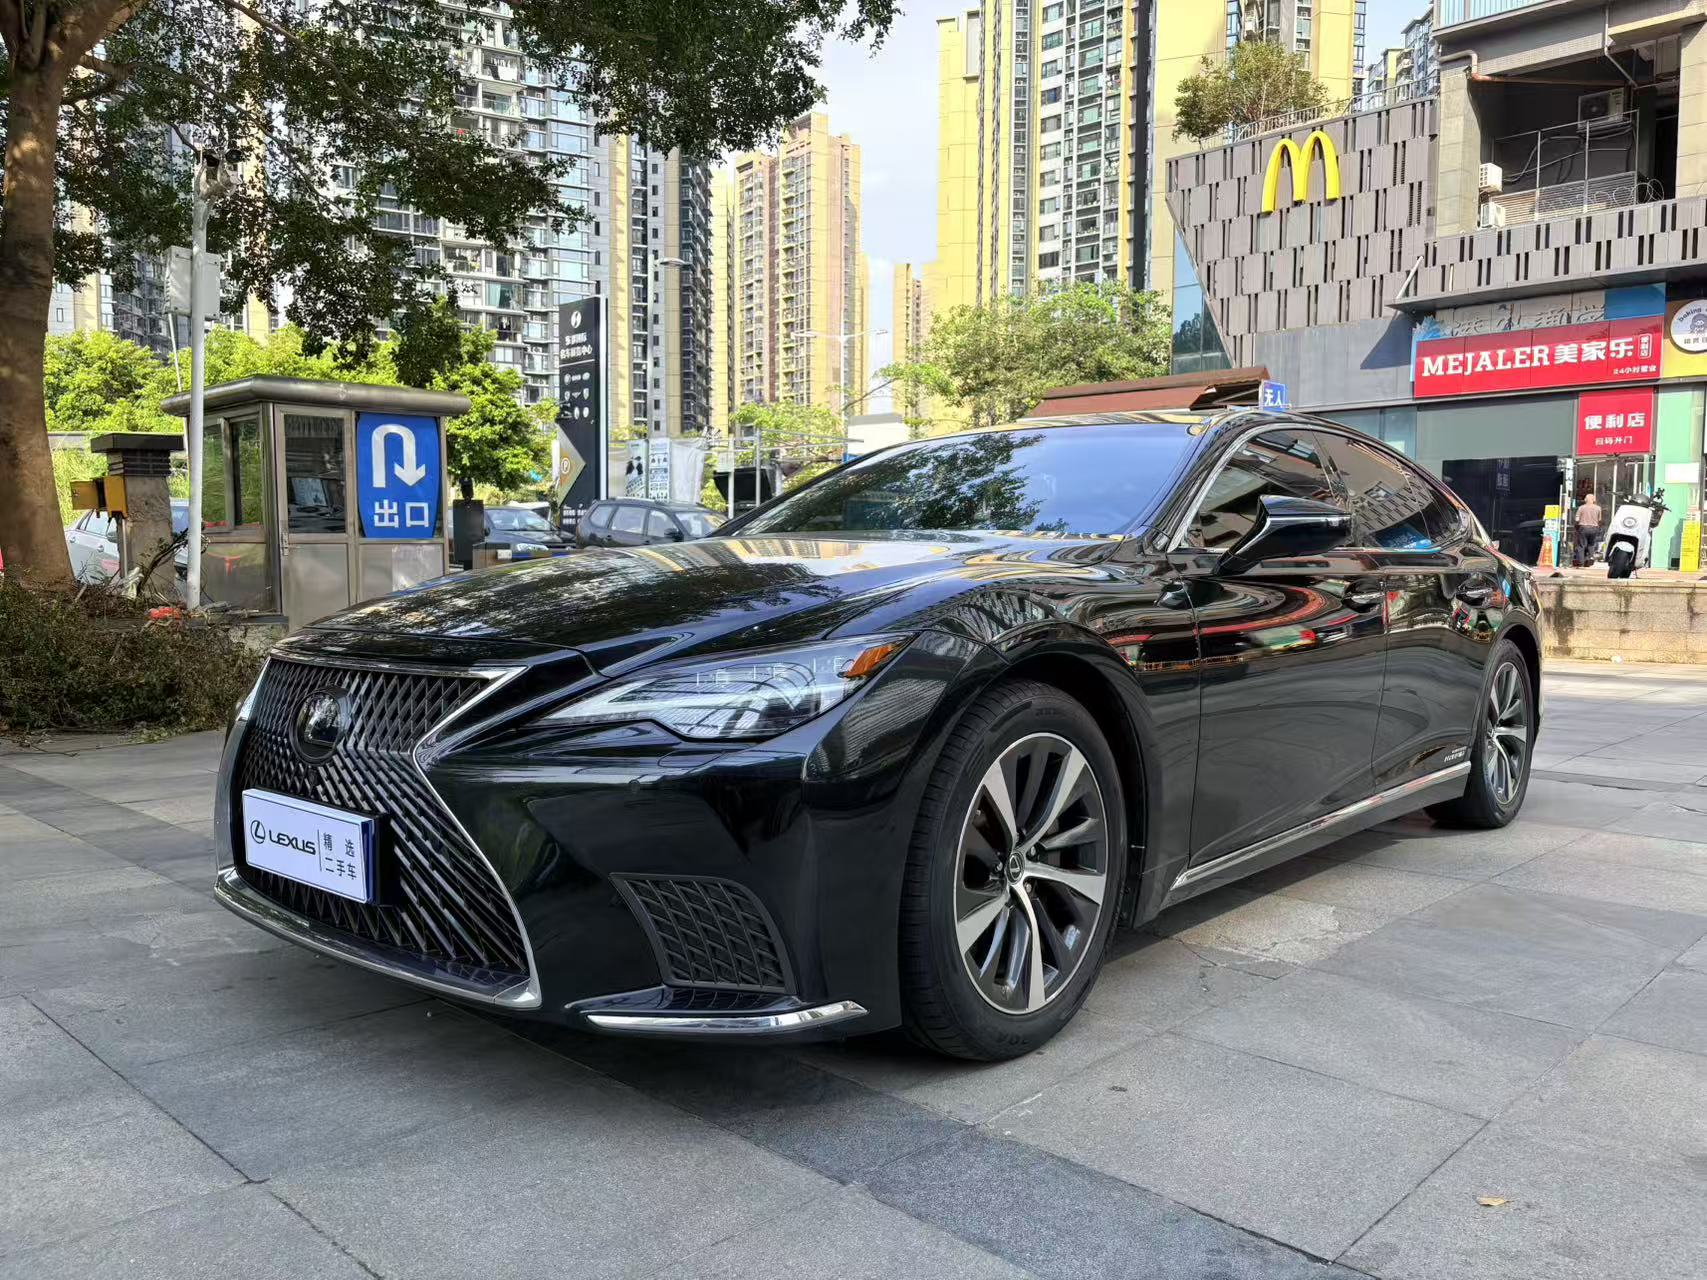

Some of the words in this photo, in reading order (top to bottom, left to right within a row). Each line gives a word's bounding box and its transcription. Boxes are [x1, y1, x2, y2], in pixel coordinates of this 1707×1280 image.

[1421, 345, 1550, 377] MEJALER
[1554, 337, 1634, 364] 美家乐
[1584, 412, 1646, 430] 便利店
[373, 499, 429, 528] 出口
[268, 829, 316, 855] LEXUS
[323, 832, 355, 857] 精选
[324, 857, 357, 880] 二手车
